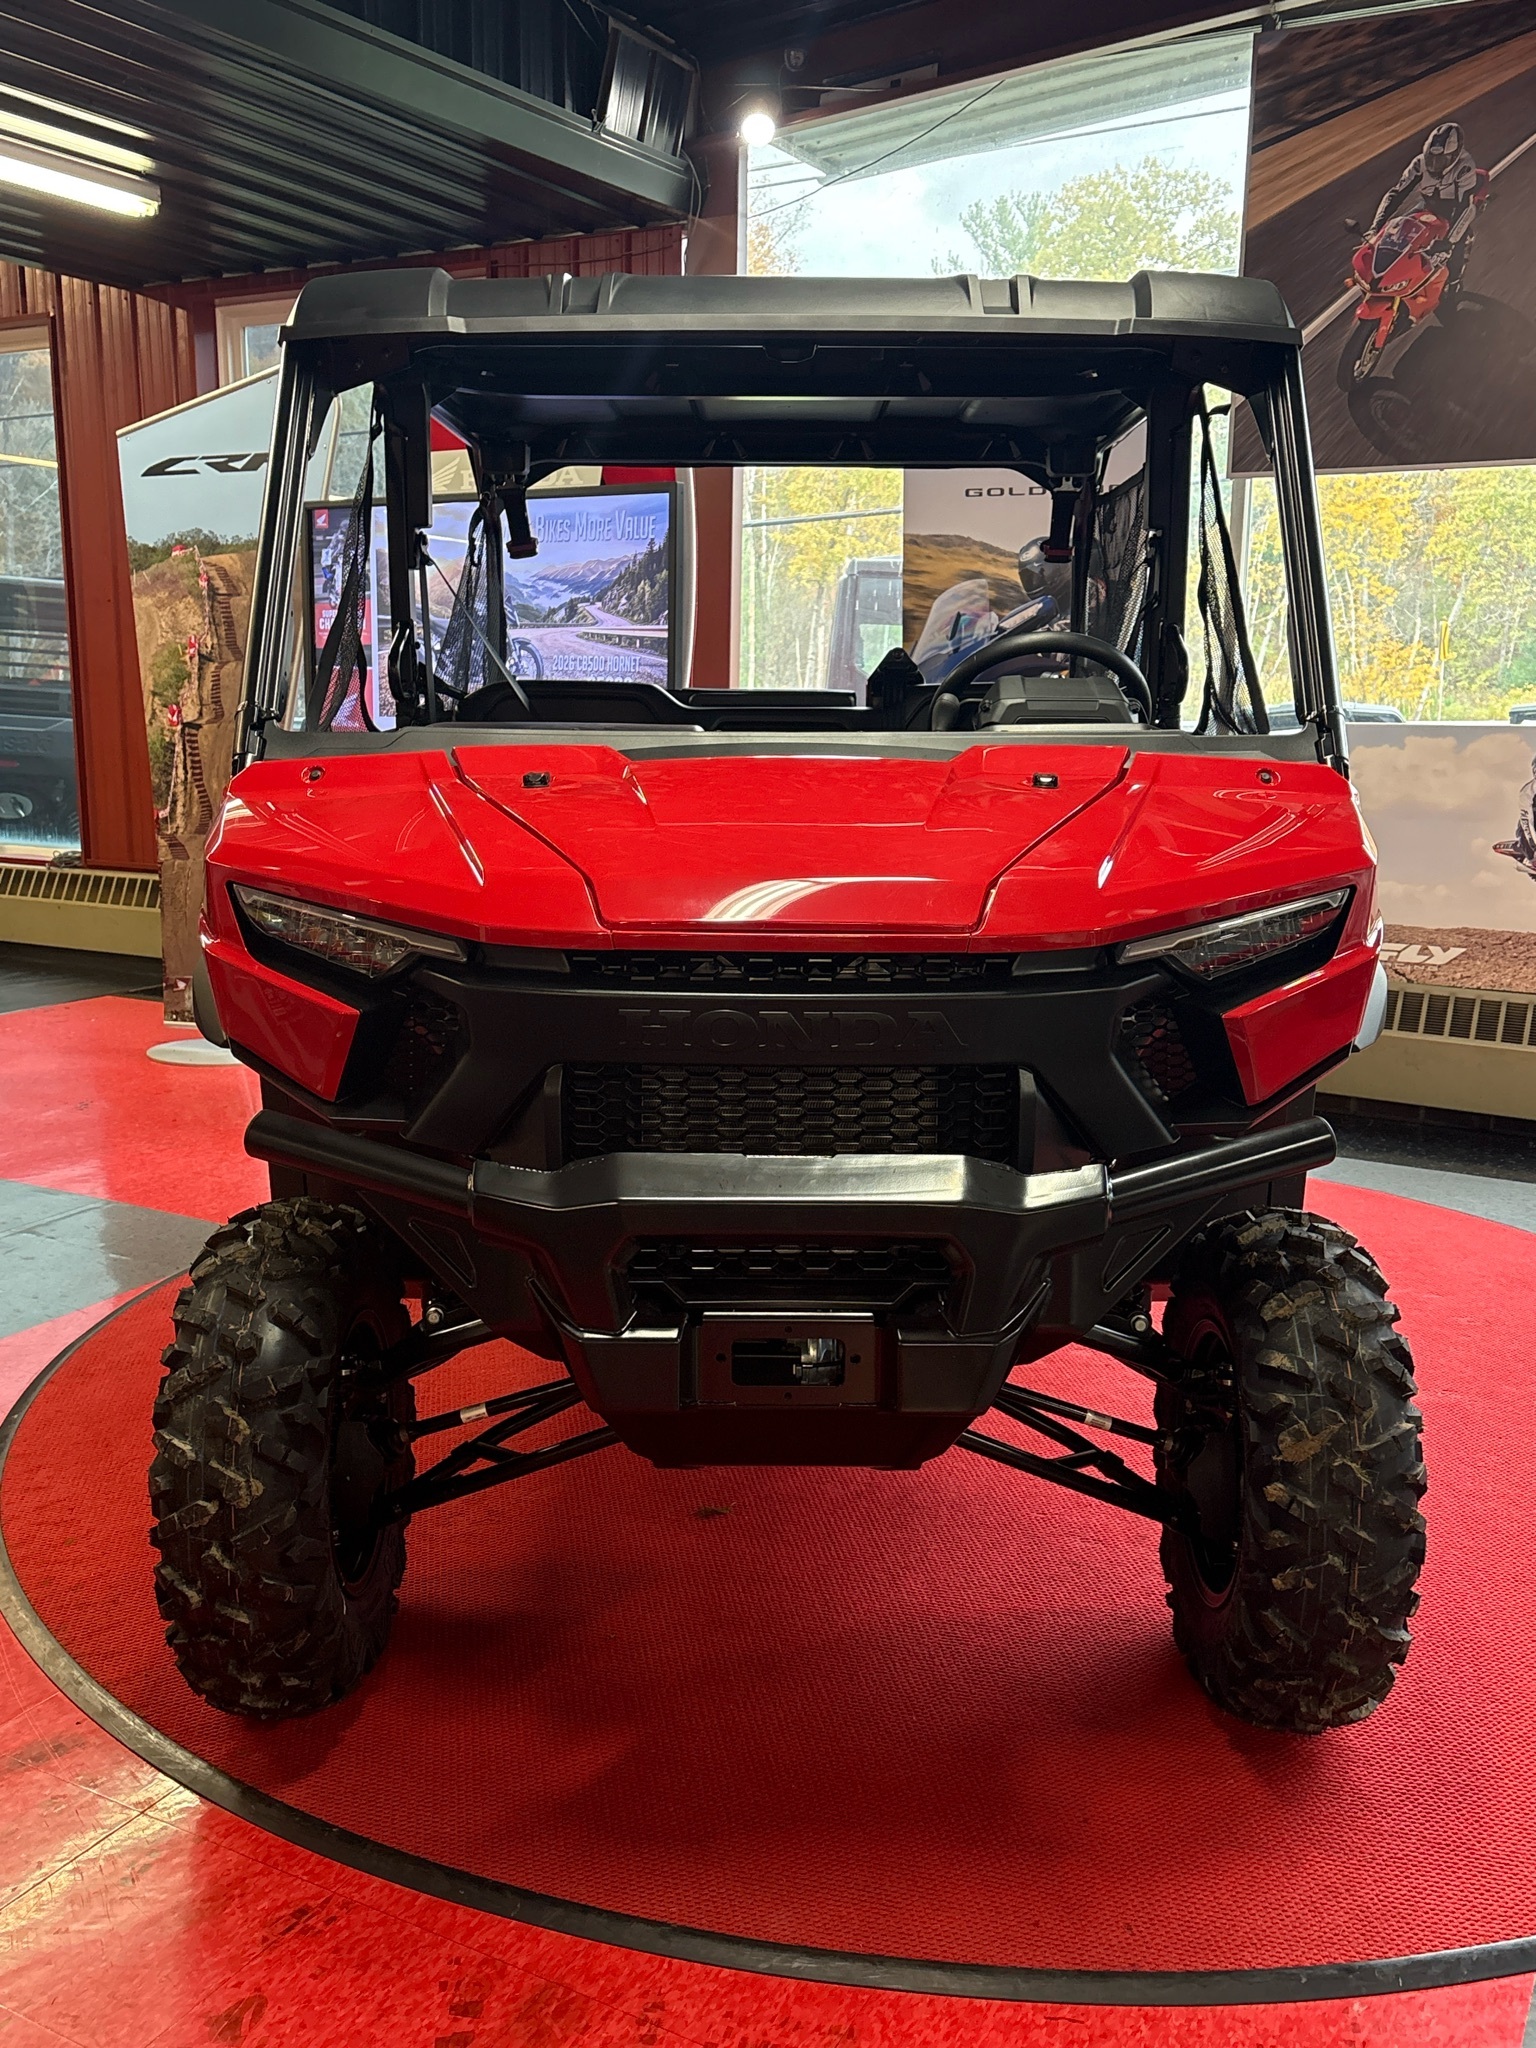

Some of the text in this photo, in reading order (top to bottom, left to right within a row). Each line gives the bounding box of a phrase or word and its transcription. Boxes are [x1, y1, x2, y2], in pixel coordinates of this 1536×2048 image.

[965, 486, 1047, 498] GOLD
[575, 511, 611, 542] MORE
[615, 510, 657, 540] VALUE
[552, 655, 641, 672] 2026 CB500 HORNET
[1379, 942, 1467, 965] FLY
[618, 1009, 968, 1047] HONDA
